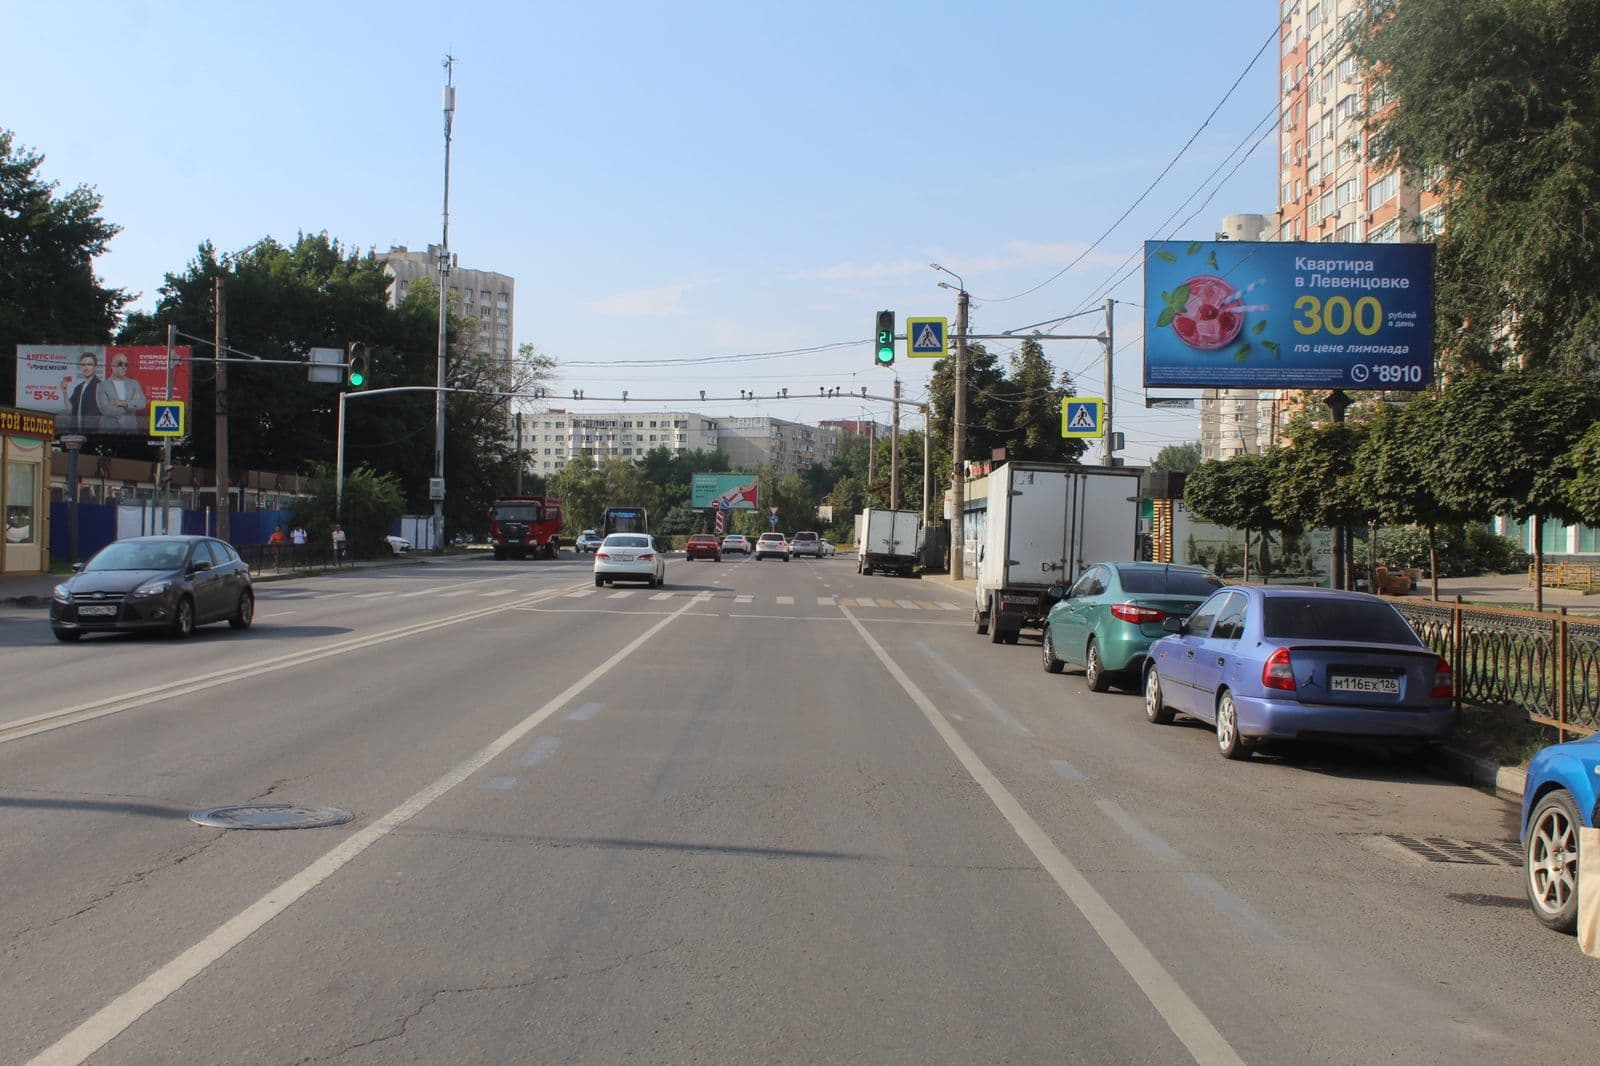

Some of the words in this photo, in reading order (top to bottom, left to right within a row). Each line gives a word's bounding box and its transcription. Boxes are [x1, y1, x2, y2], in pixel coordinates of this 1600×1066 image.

[1295, 257, 1374, 274] Квартира
[1295, 277, 1304, 287] в
[1309, 274, 1410, 290] Левенцовке
[1293, 295, 1382, 335] 300
[1388, 312, 1417, 321] рублей
[880, 331, 892, 343] 21
[1294, 344, 1310, 353] по
[1313, 344, 1344, 354] цене
[1346, 344, 1409, 355] лимонада
[34, 390, 60, 401] 5%
